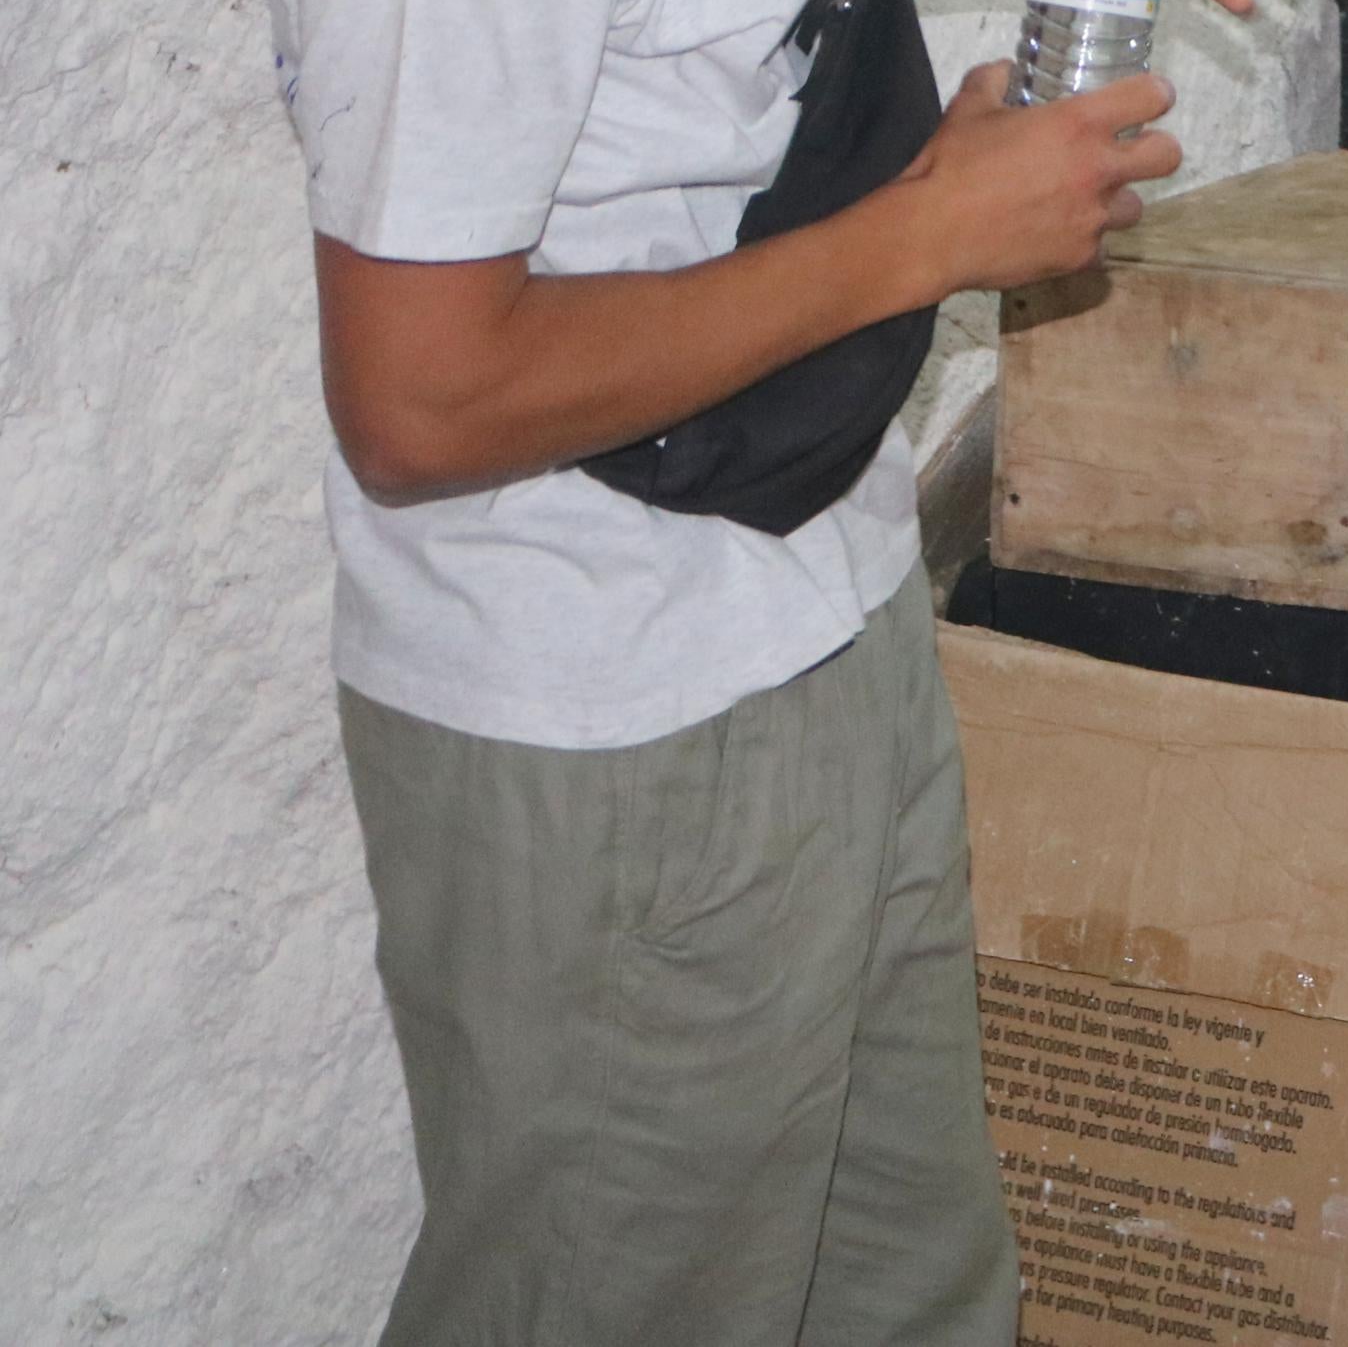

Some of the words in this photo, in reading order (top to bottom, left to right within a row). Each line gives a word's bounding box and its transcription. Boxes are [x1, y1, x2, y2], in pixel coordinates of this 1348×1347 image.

[989, 969, 1019, 994] debe
[1024, 982, 1041, 999] ser
[1045, 983, 1100, 1011] instalado
[1105, 998, 1162, 1024] conforme
[1168, 1007, 1179, 1028] la
[1183, 1010, 1201, 1035] ley
[1206, 1018, 1251, 1043] vigente
[1256, 1030, 1264, 1048] y
[1030, 1008, 1044, 1025] en
[1048, 1007, 1077, 1031] local
[1081, 1014, 1106, 1038] bien
[1112, 1026, 1171, 1051] ventilado.
[986, 1019, 1000, 1041] de
[1004, 1024, 1081, 1058] instrucciones
[1123, 1047, 1138, 1069] de
[1143, 1053, 1188, 1080] instalar
[1204, 1068, 1246, 1092] utilizar
[1251, 1080, 1276, 1099] este
[1281, 1086, 1333, 1111] aparato.
[1029, 1055, 1040, 1075] el
[1044, 1063, 1090, 1085] aparato
[1096, 1067, 1124, 1092] debe
[1130, 1075, 1181, 1104] disponer
[1186, 1086, 1200, 1108] de
[1206, 1097, 1220, 1113] un
[1226, 1097, 1253, 1120] tubo
[1257, 1101, 1303, 1130] flexible
[1000, 1104, 1013, 1120] es
[1018, 1104, 1075, 1133] adecuado
[1080, 1121, 1106, 1139] para
[1112, 1125, 1178, 1154] calefacción
[1045, 1082, 1060, 1104] de
[1064, 1092, 1080, 1109] un
[1084, 1096, 1142, 1122] regulador
[1146, 1103, 1161, 1126] de
[1166, 1113, 1209, 1136] presión
[1216, 1118, 1296, 1154] homologado.
[1017, 1182, 1041, 1201] well
[1021, 1155, 1035, 1175] be
[1040, 1160, 1090, 1187] installed
[1158, 1186, 1169, 1203] to
[1174, 1188, 1194, 1209] the
[1271, 1211, 1296, 1230] and
[1026, 1205, 1064, 1232] before
[1127, 1232, 1139, 1248] or
[1144, 1234, 1176, 1260] using
[1181, 1239, 1200, 1261] the
[1035, 1237, 1092, 1265] appliance
[1097, 1252, 1126, 1272] must
[1131, 1253, 1159, 1279] have
[1165, 1266, 1172, 1282] a
[1177, 1262, 1221, 1292] flexible
[1226, 1275, 1253, 1299] tube
[1259, 1283, 1283, 1305] and
[1285, 1291, 1295, 1307] a
[1038, 1265, 1089, 1290] pressure
[1157, 1285, 1202, 1314] Contact
[1206, 1301, 1234, 1321] your
[1238, 1307, 1261, 1327] gas
[1264, 1307, 1331, 1341] distributor.
[1036, 1285, 1054, 1307] for
[1057, 1294, 1103, 1322] primary
[1108, 1300, 1154, 1332] heating
[1157, 1316, 1216, 1341] purposes.
